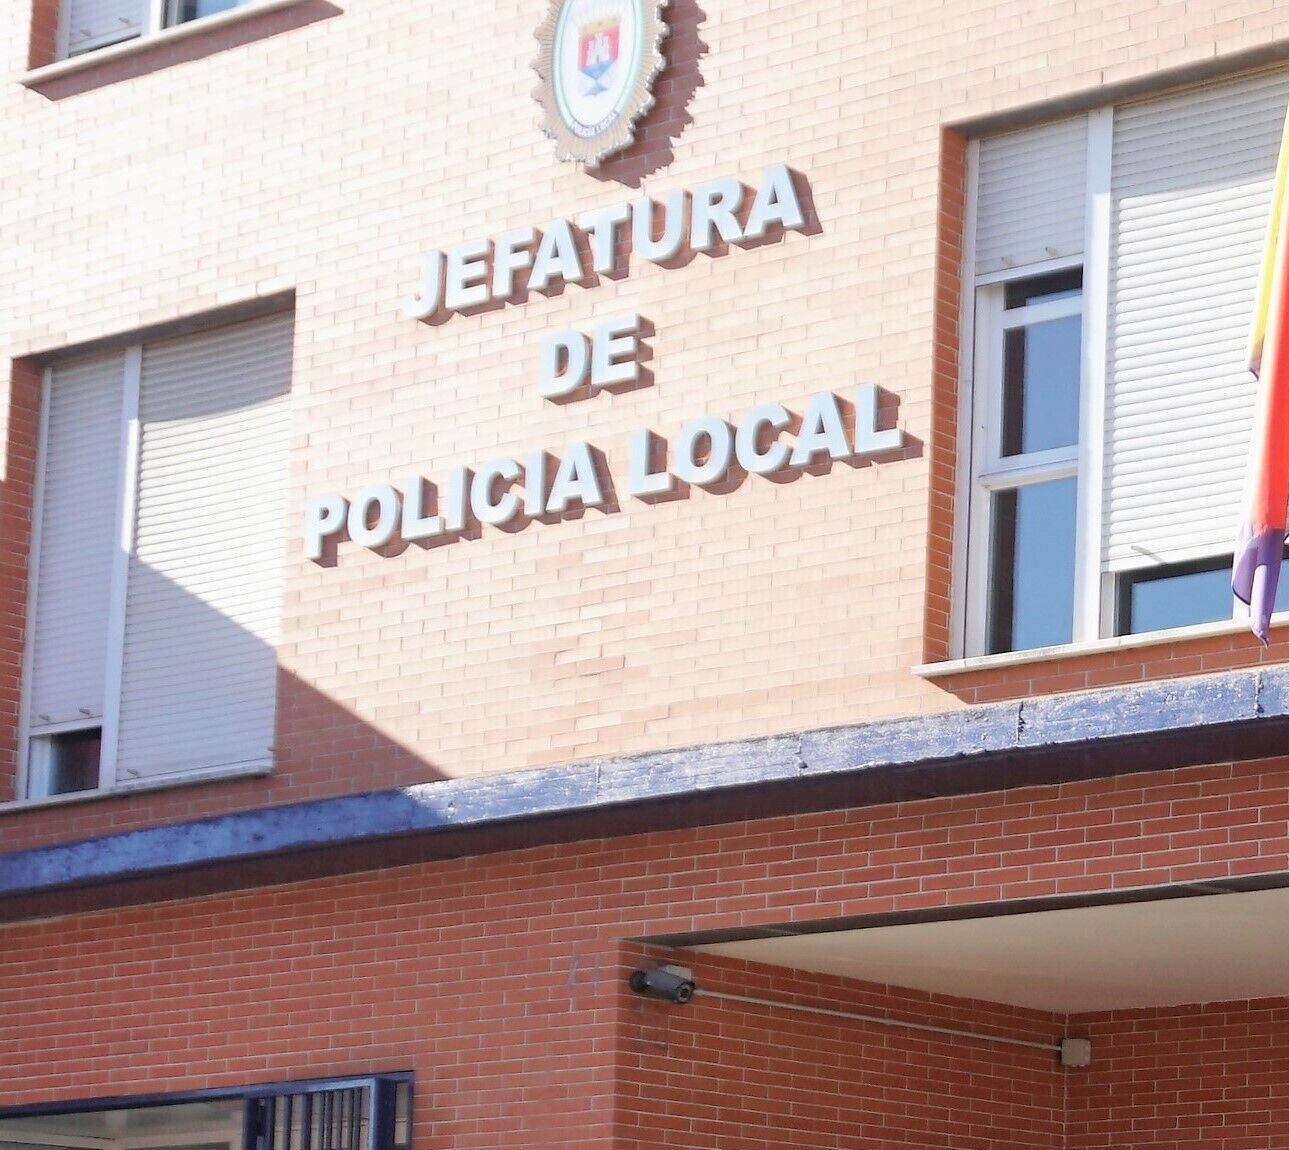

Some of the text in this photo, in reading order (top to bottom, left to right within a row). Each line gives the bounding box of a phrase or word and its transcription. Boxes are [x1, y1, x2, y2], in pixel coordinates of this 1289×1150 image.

[407, 163, 803, 321] JEFATURA
[540, 313, 641, 402] DE
[303, 382, 902, 562] POLICIA LOCAL
